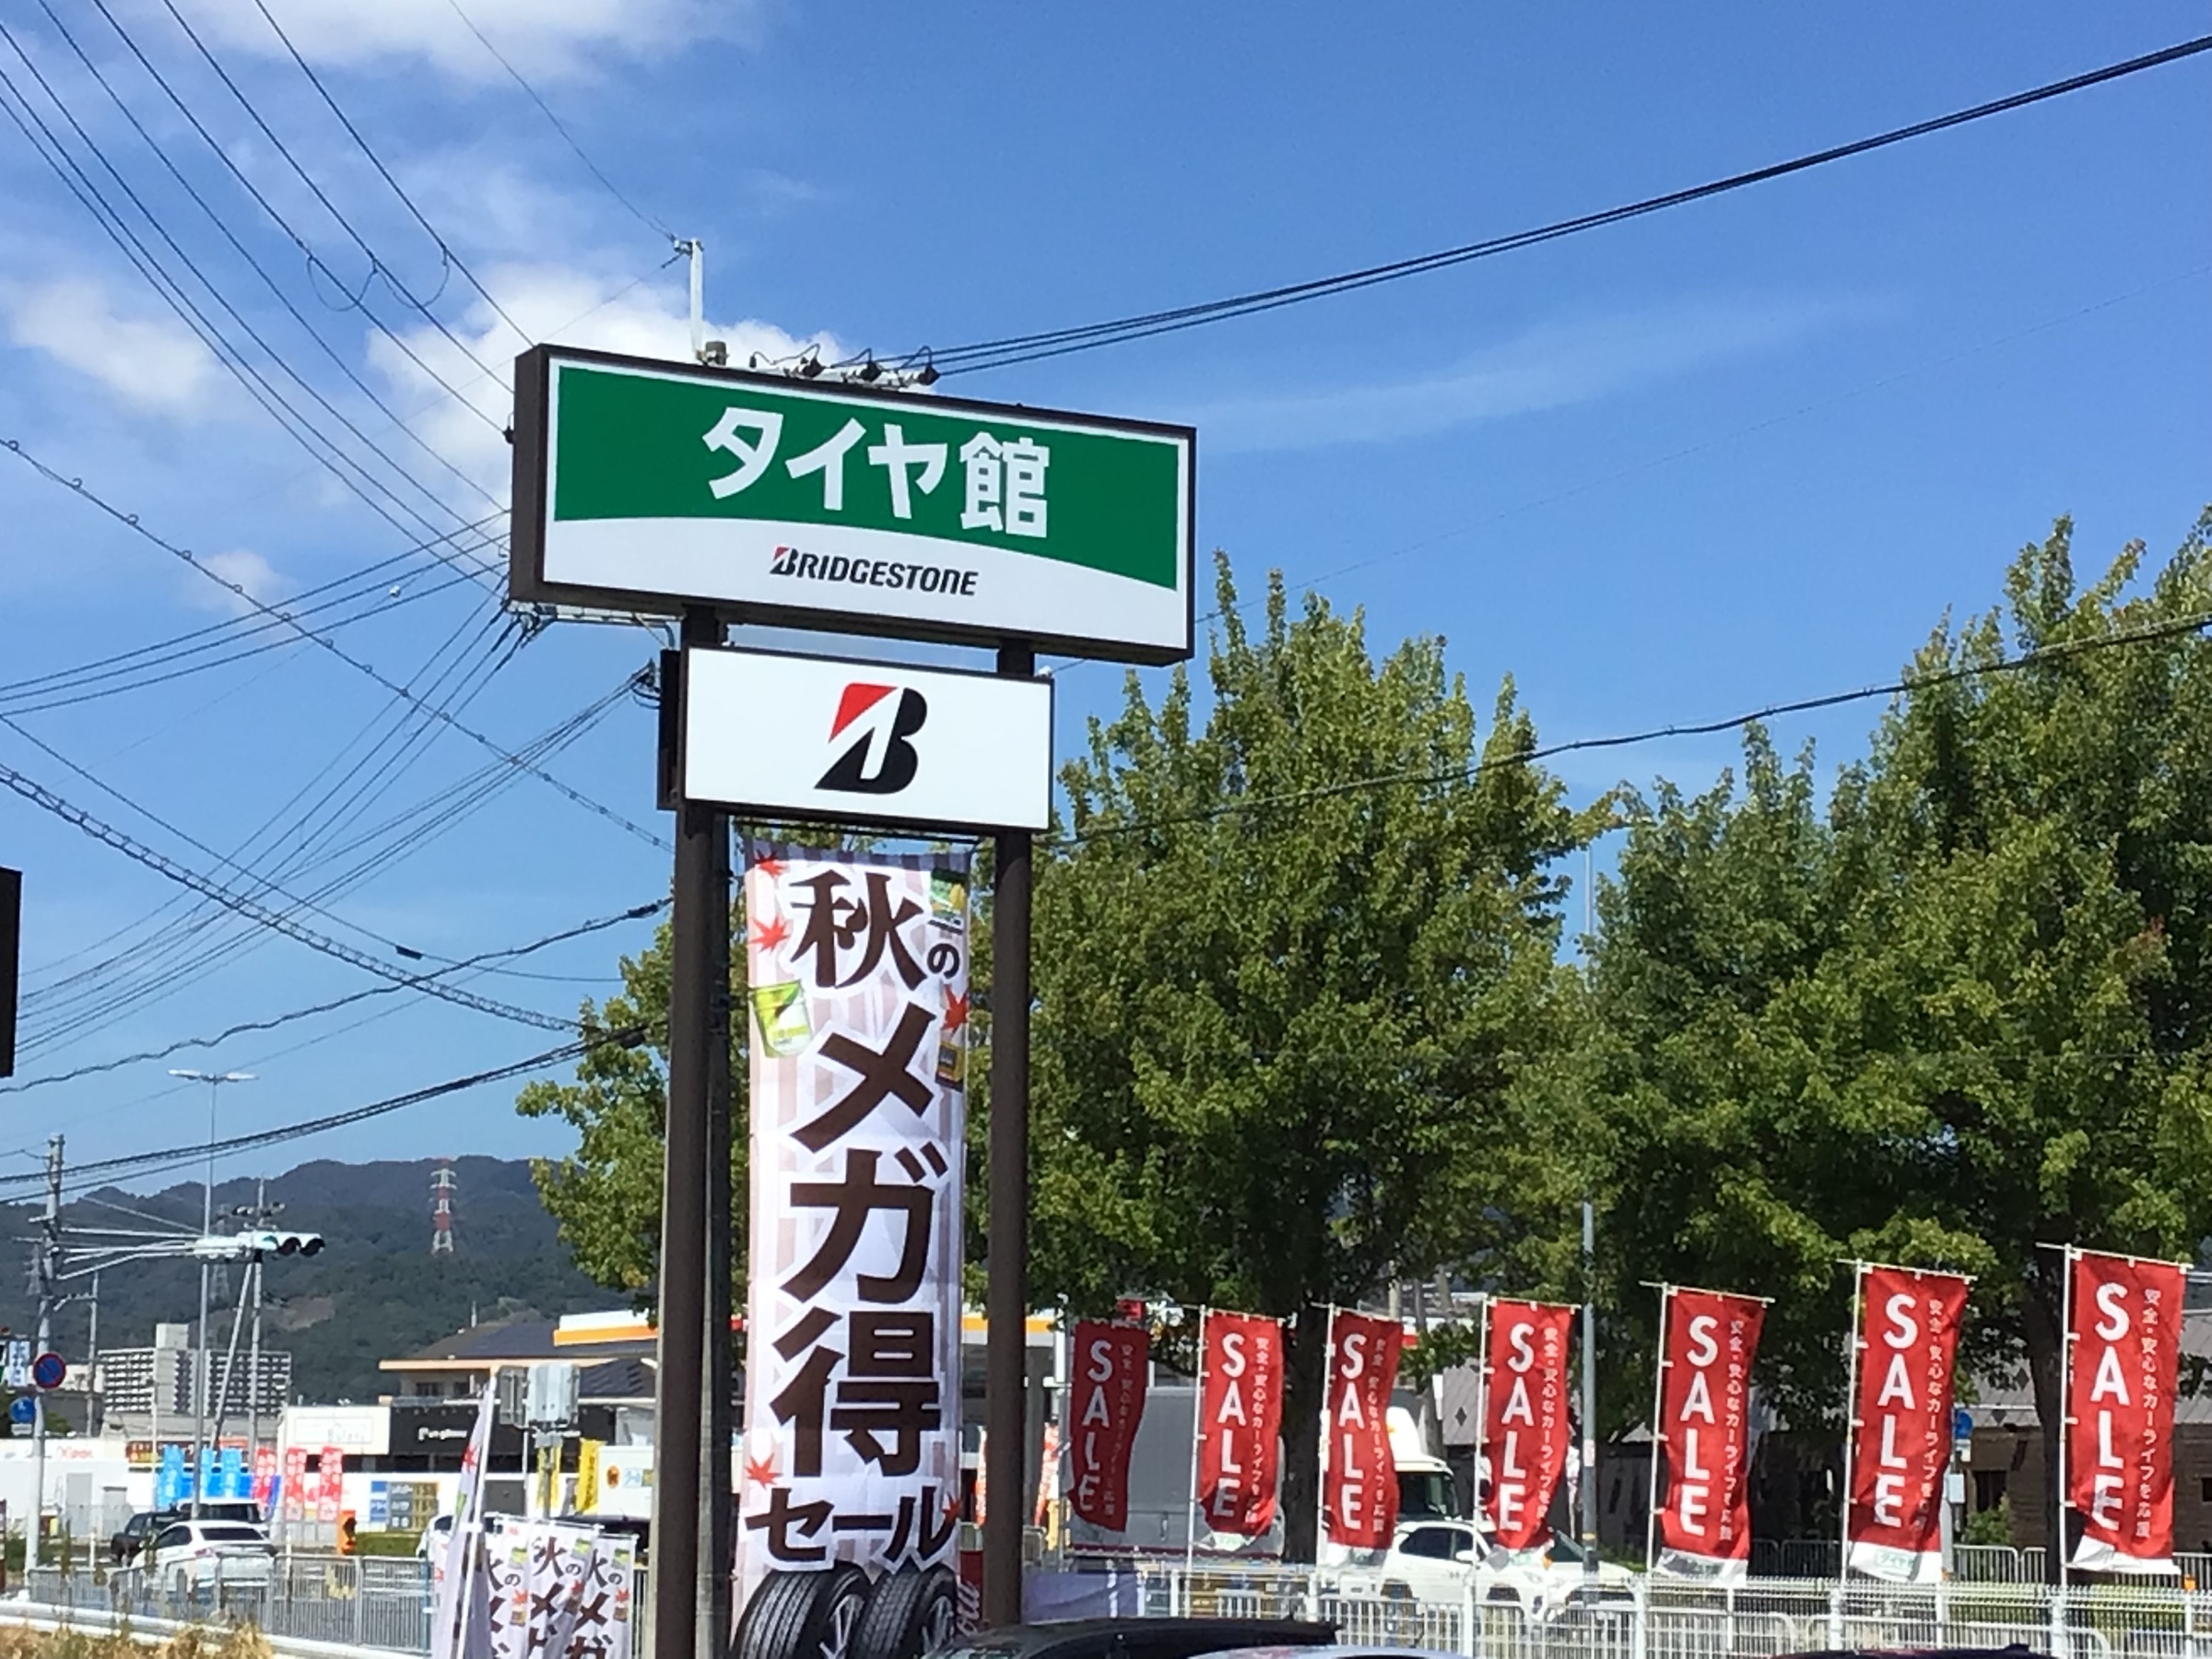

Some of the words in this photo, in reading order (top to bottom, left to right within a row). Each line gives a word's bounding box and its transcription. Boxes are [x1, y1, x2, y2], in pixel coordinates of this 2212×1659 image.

[702, 407, 1051, 538] タイヤ館
[770, 546, 979, 596] BRIDGESTONE
[1078, 1339, 1112, 1512] SALE
[1213, 1333, 1248, 1517] SALE
[1338, 1333, 1368, 1530] SALE
[1499, 1323, 1535, 1532] SALE
[1679, 1315, 1719, 1536] SALE
[1877, 1294, 1917, 1527] SALE
[2090, 1282, 2131, 1531] SALE
